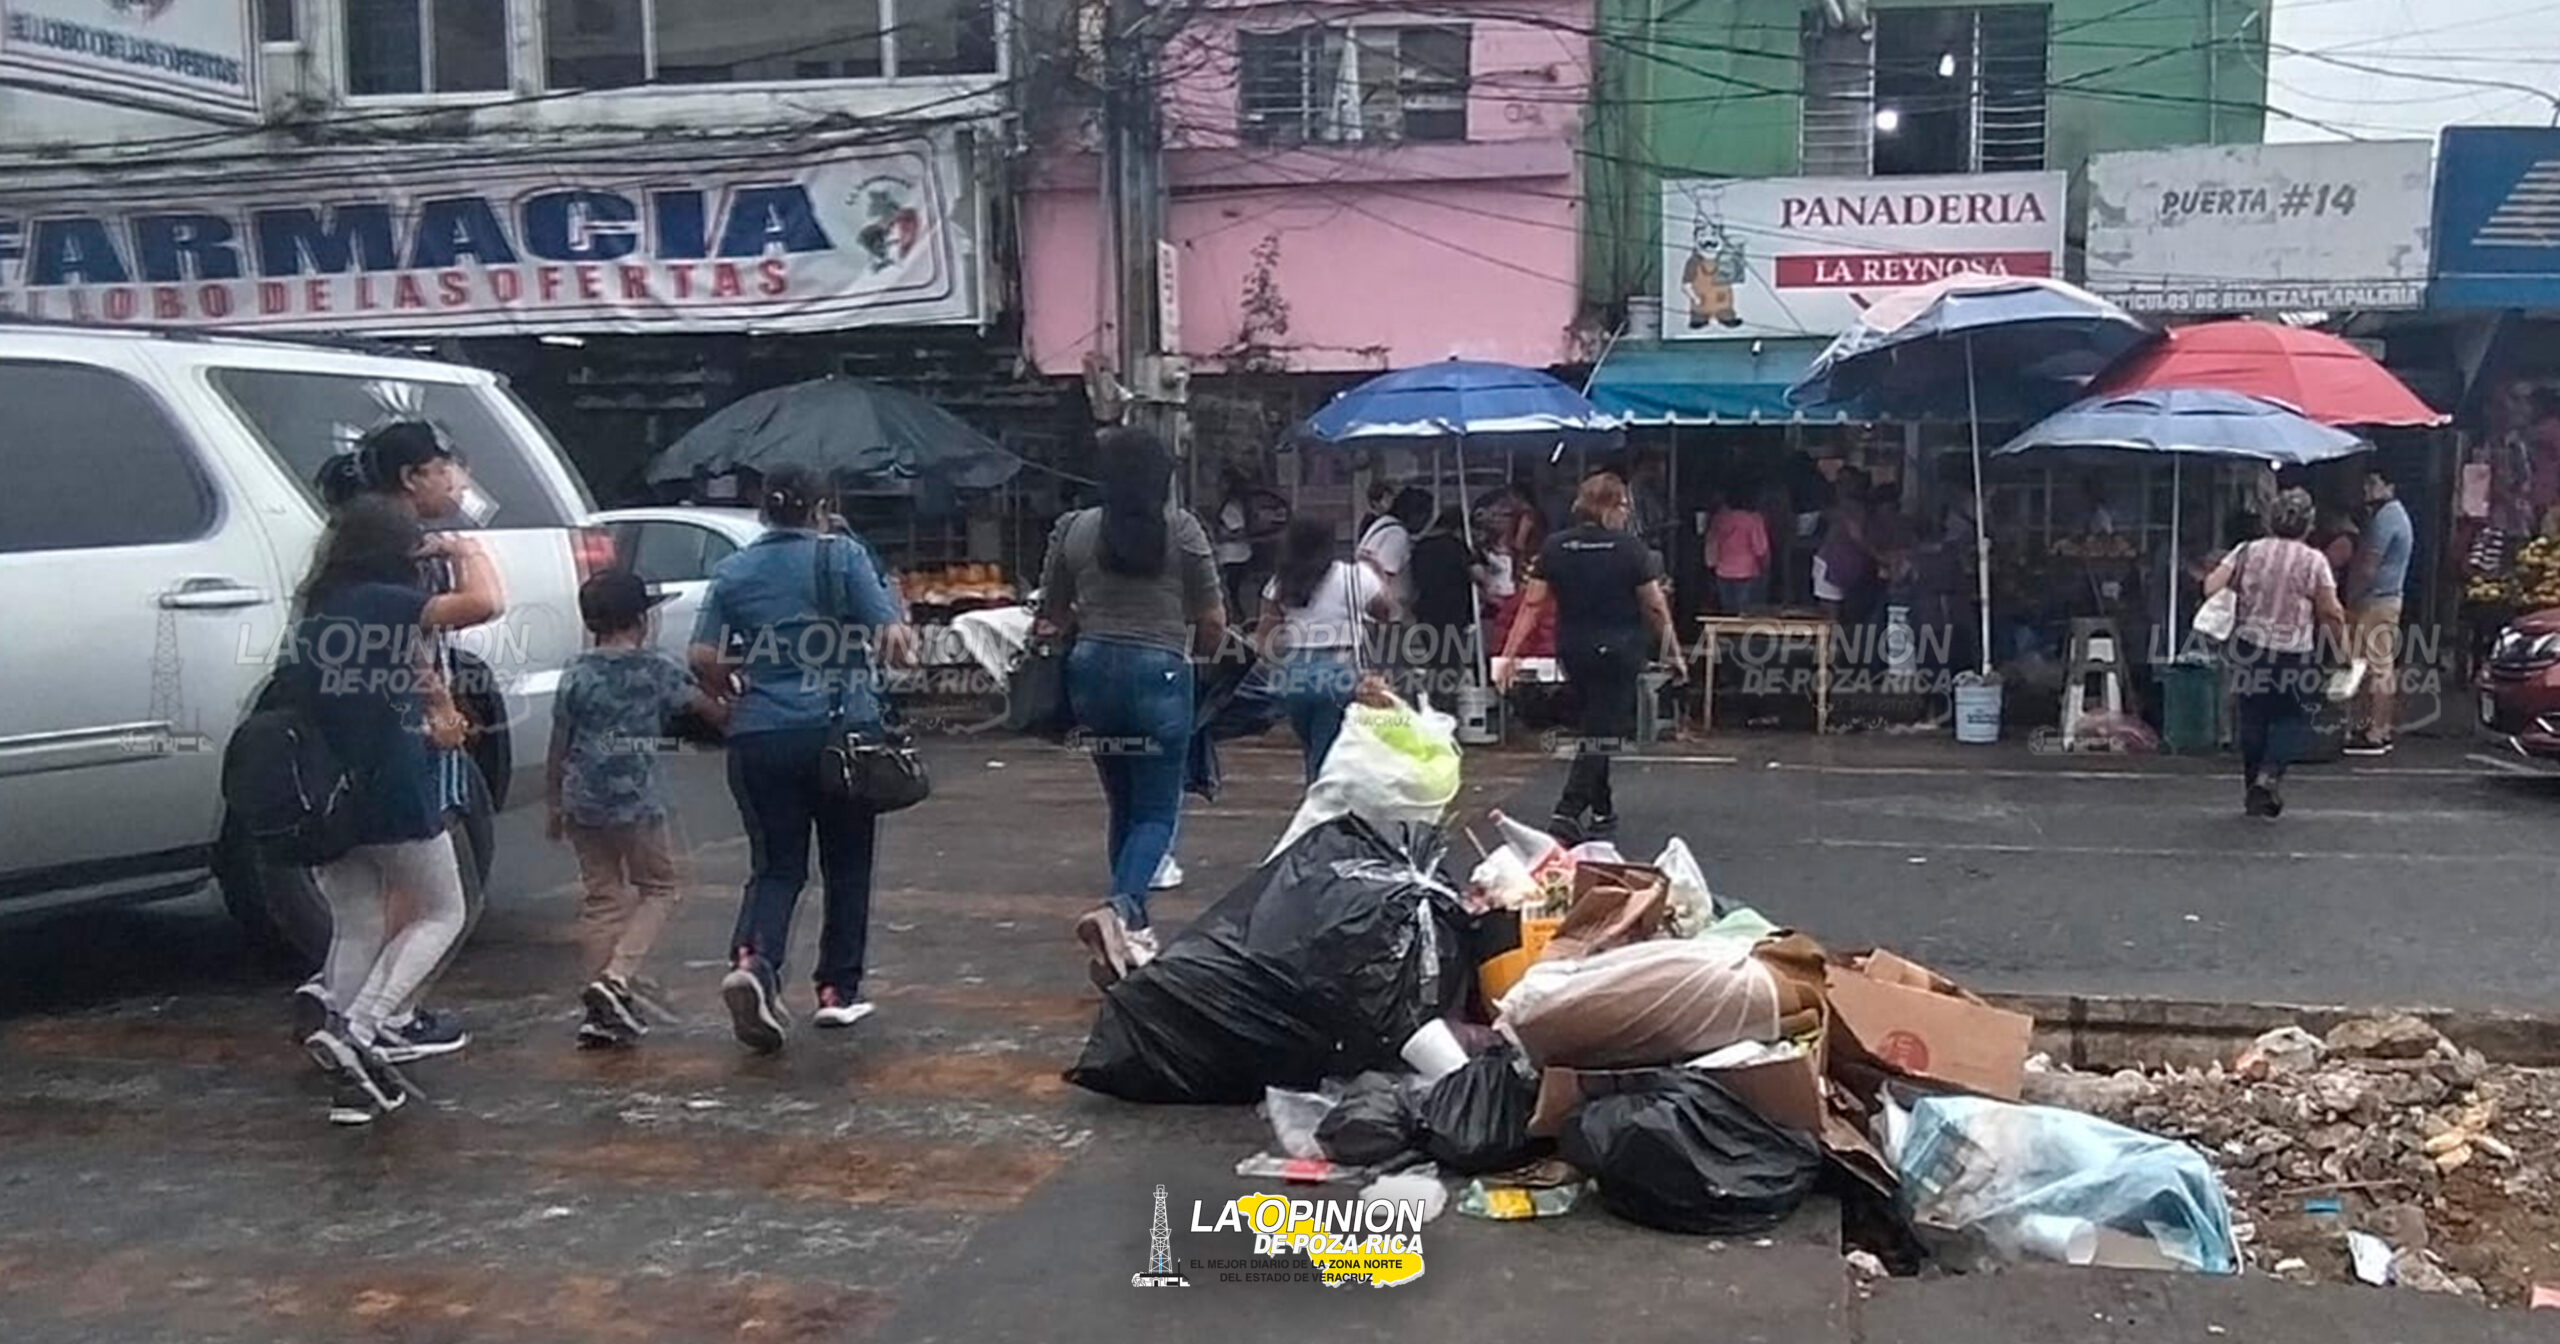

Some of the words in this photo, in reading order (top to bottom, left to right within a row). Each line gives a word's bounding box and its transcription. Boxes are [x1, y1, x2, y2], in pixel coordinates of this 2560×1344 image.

[1780, 192, 2046, 228] PANADERIA
[2161, 188, 2267, 215] PUERTA
[2278, 183, 2357, 217] #14
[1815, 261, 1854, 282] LA
[1863, 257, 2008, 281] REYNOSA
[70, 285, 236, 320] LOBO
[260, 278, 332, 313] DE
[356, 271, 467, 309] LAS
[489, 257, 790, 302] OFERTAS
